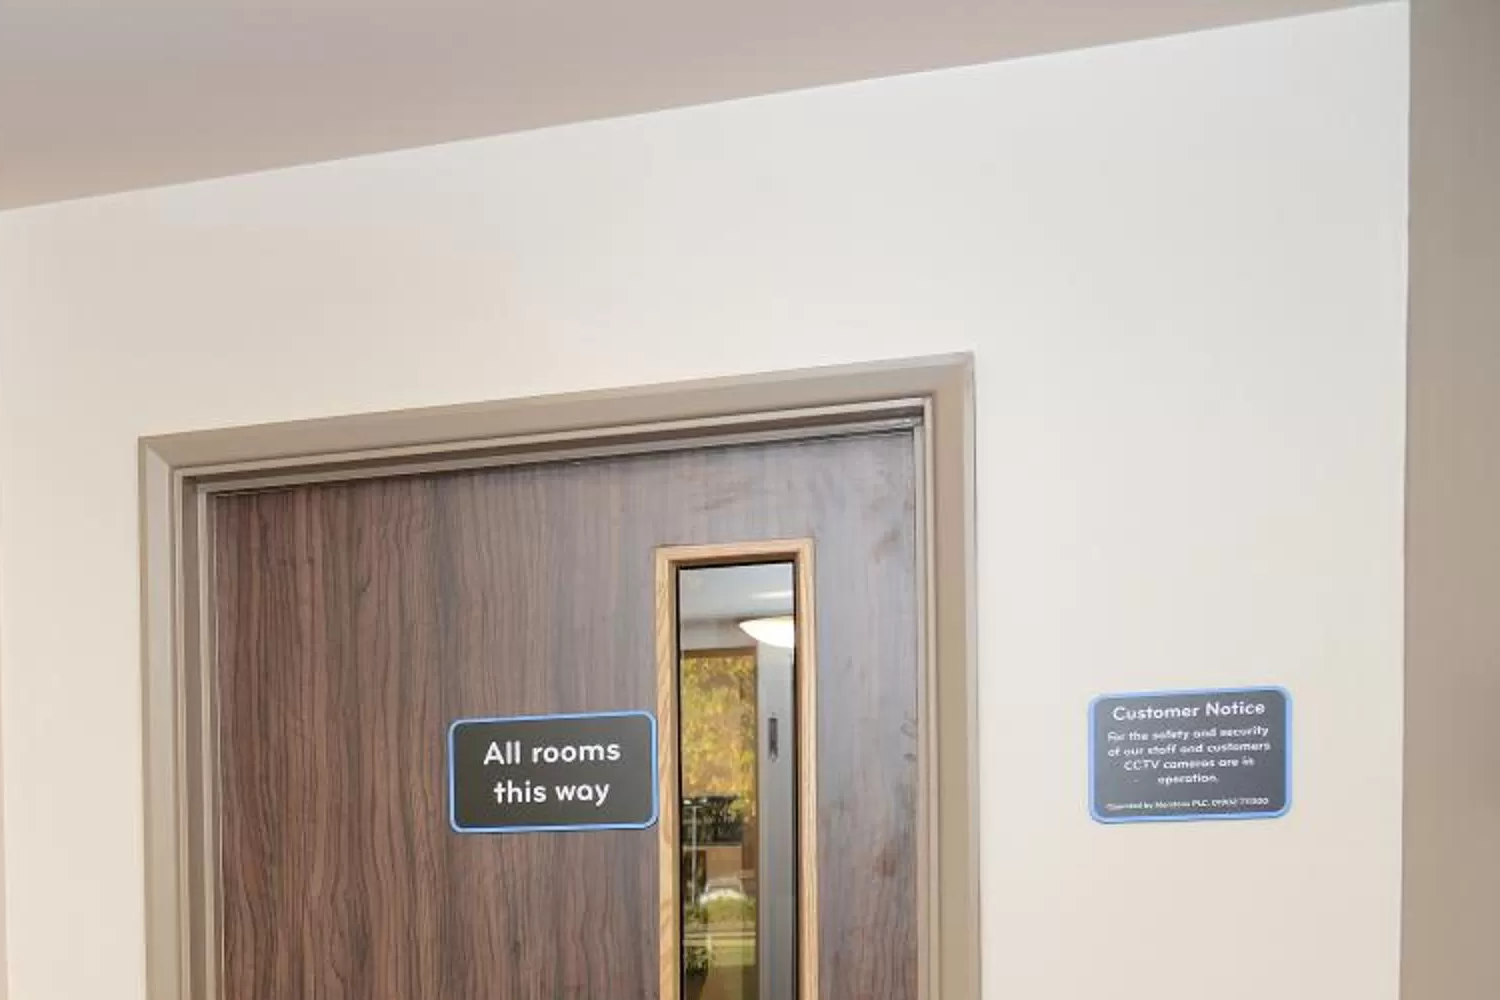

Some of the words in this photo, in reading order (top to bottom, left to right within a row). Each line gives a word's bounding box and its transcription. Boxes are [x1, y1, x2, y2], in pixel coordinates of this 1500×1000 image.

[1112, 705, 1200, 721] Customer
[1205, 701, 1266, 717] Notice
[1107, 732, 1125, 742] For
[1129, 731, 1149, 741] the
[1152, 730, 1190, 741] safety
[1193, 728, 1217, 738] and
[1220, 726, 1269, 738] security
[483, 740, 521, 765] All
[531, 742, 621, 763] rooms
[1108, 746, 1120, 757] of
[1123, 747, 1144, 756] our
[1147, 744, 1178, 755] staff
[1180, 744, 1203, 754] and
[1207, 742, 1271, 753] customers
[1123, 759, 1161, 771] CCTV
[1163, 759, 1215, 769] cameras
[1218, 758, 1239, 767] are
[493, 779, 547, 803] this
[555, 782, 610, 807] way
